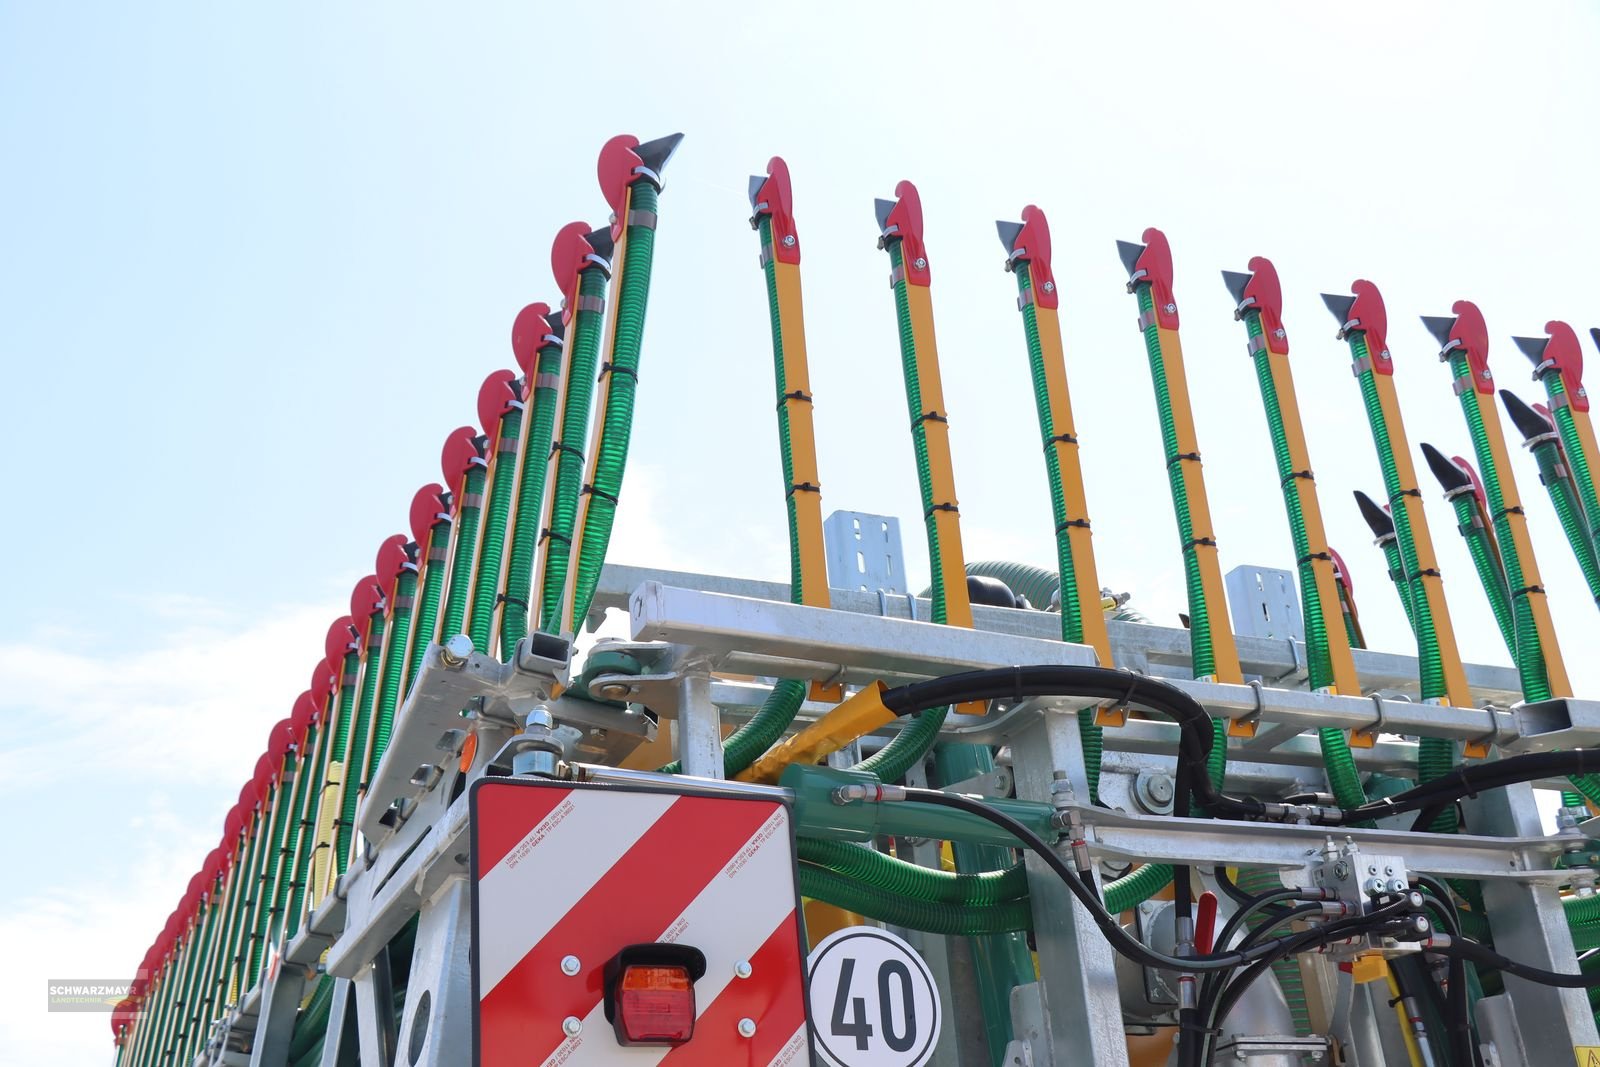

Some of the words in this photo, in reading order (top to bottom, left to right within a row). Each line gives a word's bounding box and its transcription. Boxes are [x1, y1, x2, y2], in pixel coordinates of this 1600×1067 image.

[536, 821, 549, 834] GEKA
[531, 833, 544, 847] GEKA
[751, 832, 763, 845] GEKA
[747, 844, 760, 857] GEKA
[831, 958, 916, 1052] 40
